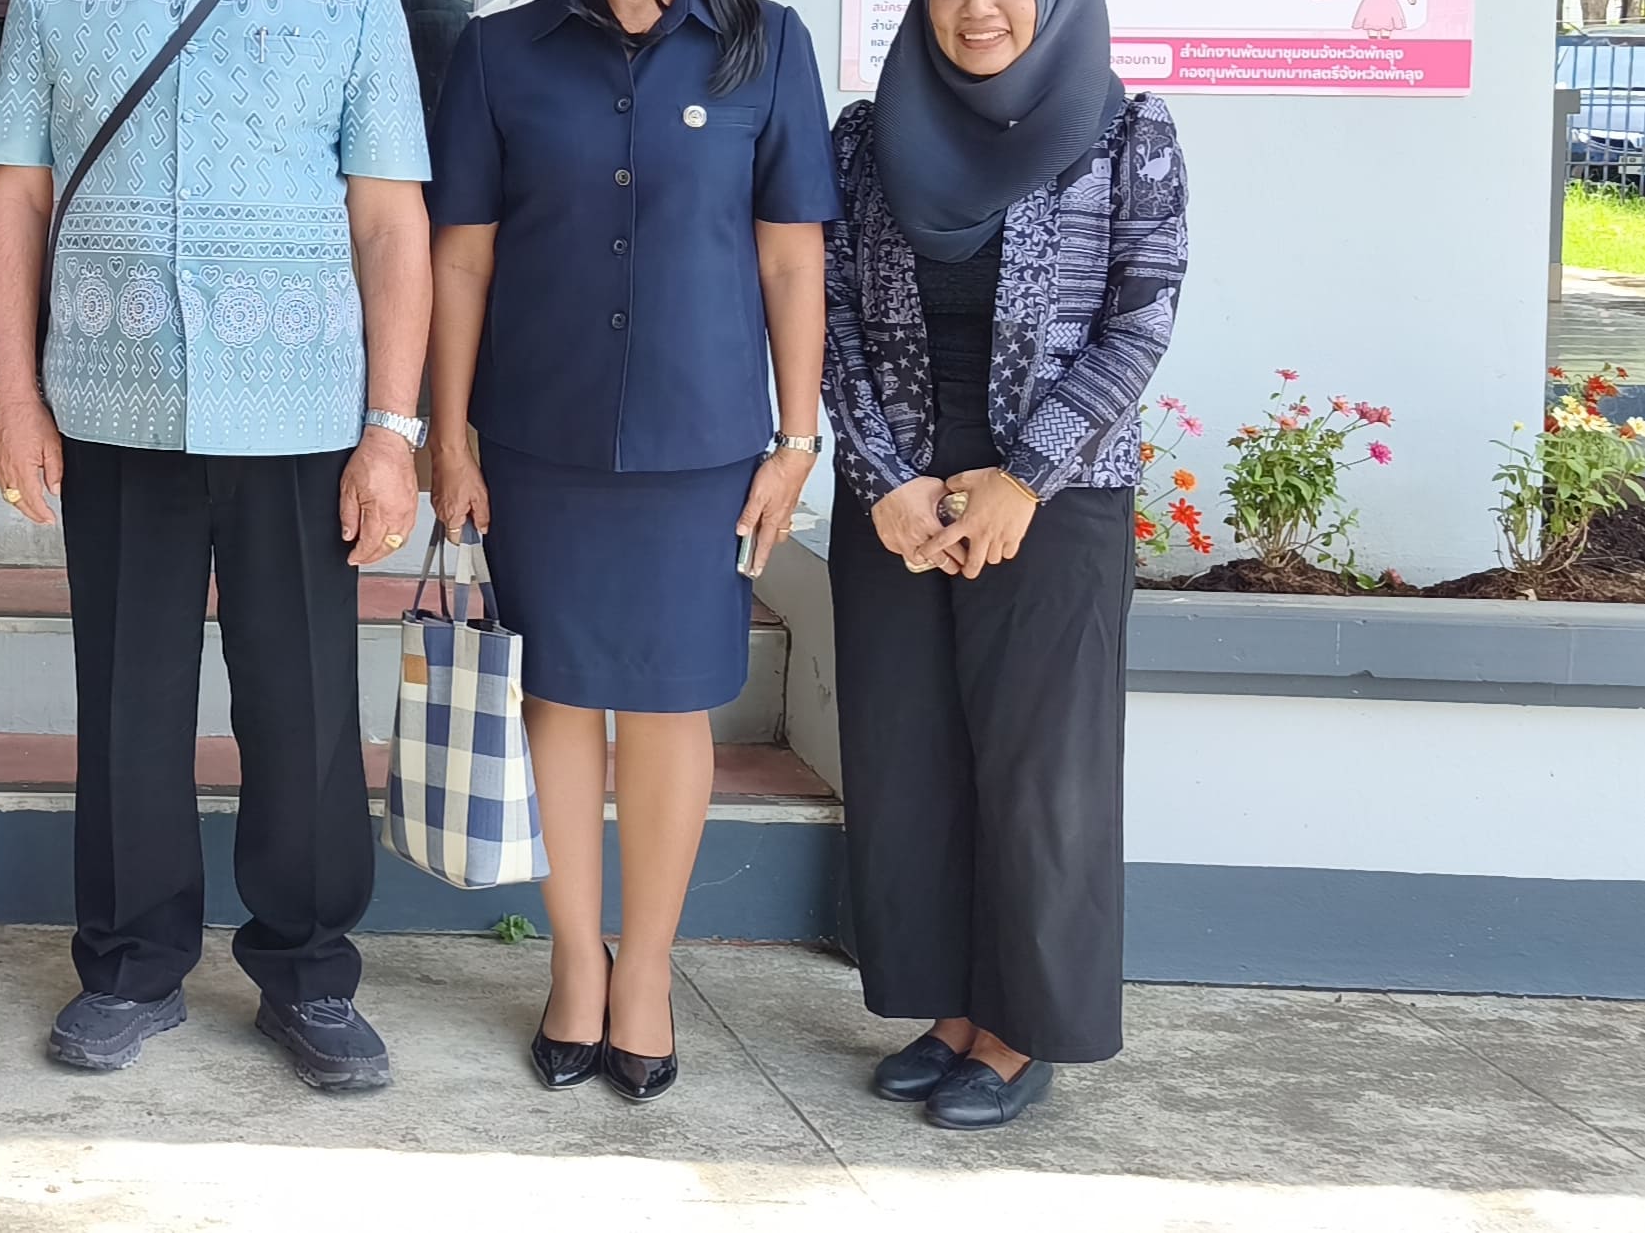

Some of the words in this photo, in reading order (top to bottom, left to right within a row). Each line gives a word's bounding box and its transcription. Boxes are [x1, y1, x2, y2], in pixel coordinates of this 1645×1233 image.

[1179, 44, 1404, 64] สำนักงานพัฒนาชุมชนจังหวัดพัทลุง
[1179, 66, 1424, 85] กองทุนพัฒนาบทบาทสตรีจังหวัดพัทลุง
